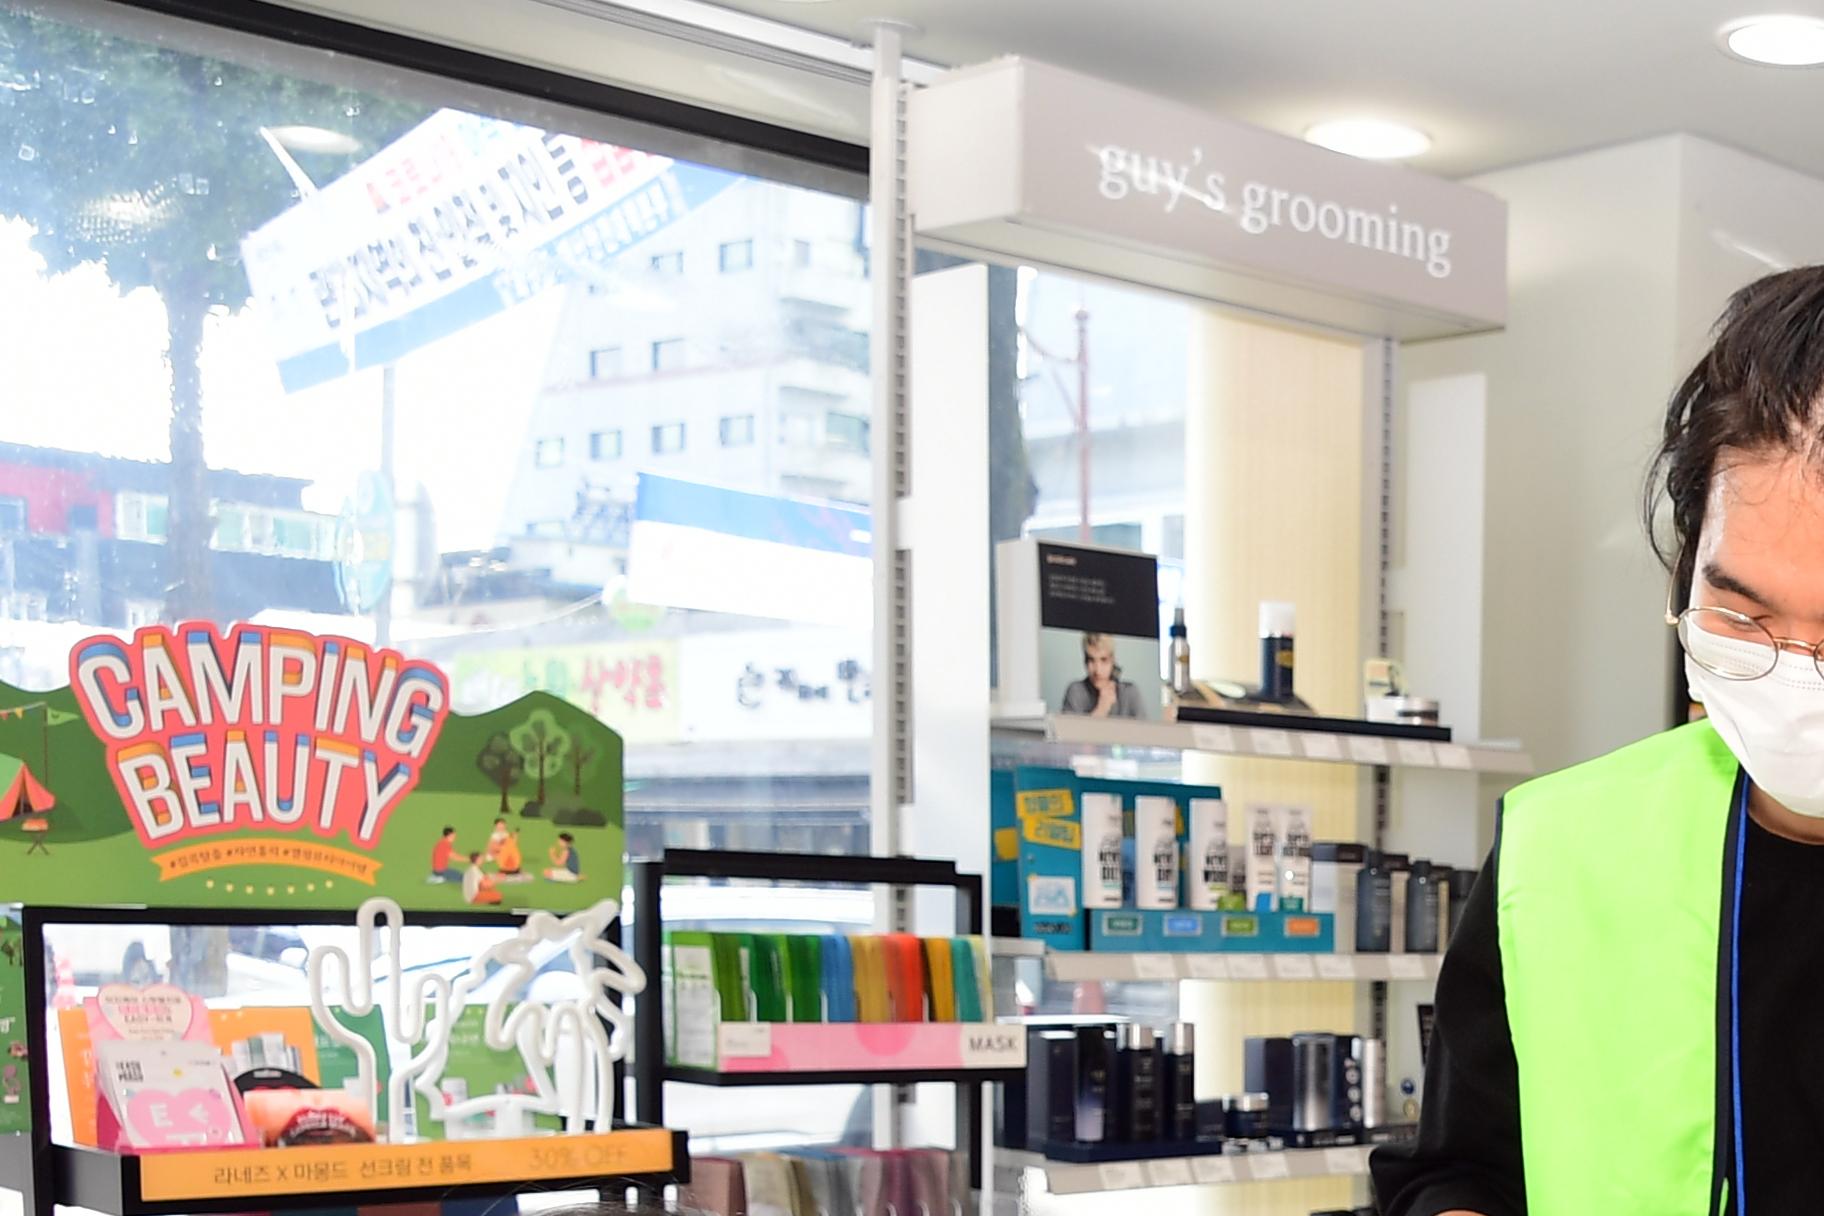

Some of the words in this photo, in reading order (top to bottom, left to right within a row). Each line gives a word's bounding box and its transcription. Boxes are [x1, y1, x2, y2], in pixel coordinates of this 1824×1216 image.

[1097, 145, 1226, 213] guy's
[1239, 180, 1453, 279] grooming
[77, 631, 444, 757] CAMPING
[117, 730, 411, 842] BEAUTY
[968, 1036, 1017, 1052] MASK
[213, 1166, 270, 1186] 라네즈
[277, 1166, 287, 1181] X
[293, 1161, 349, 1184] 마몽드
[359, 1157, 413, 1180] 선크림
[418, 1155, 433, 1176] 전
[438, 1153, 472, 1175] 품목
[528, 1149, 577, 1172] 30%
